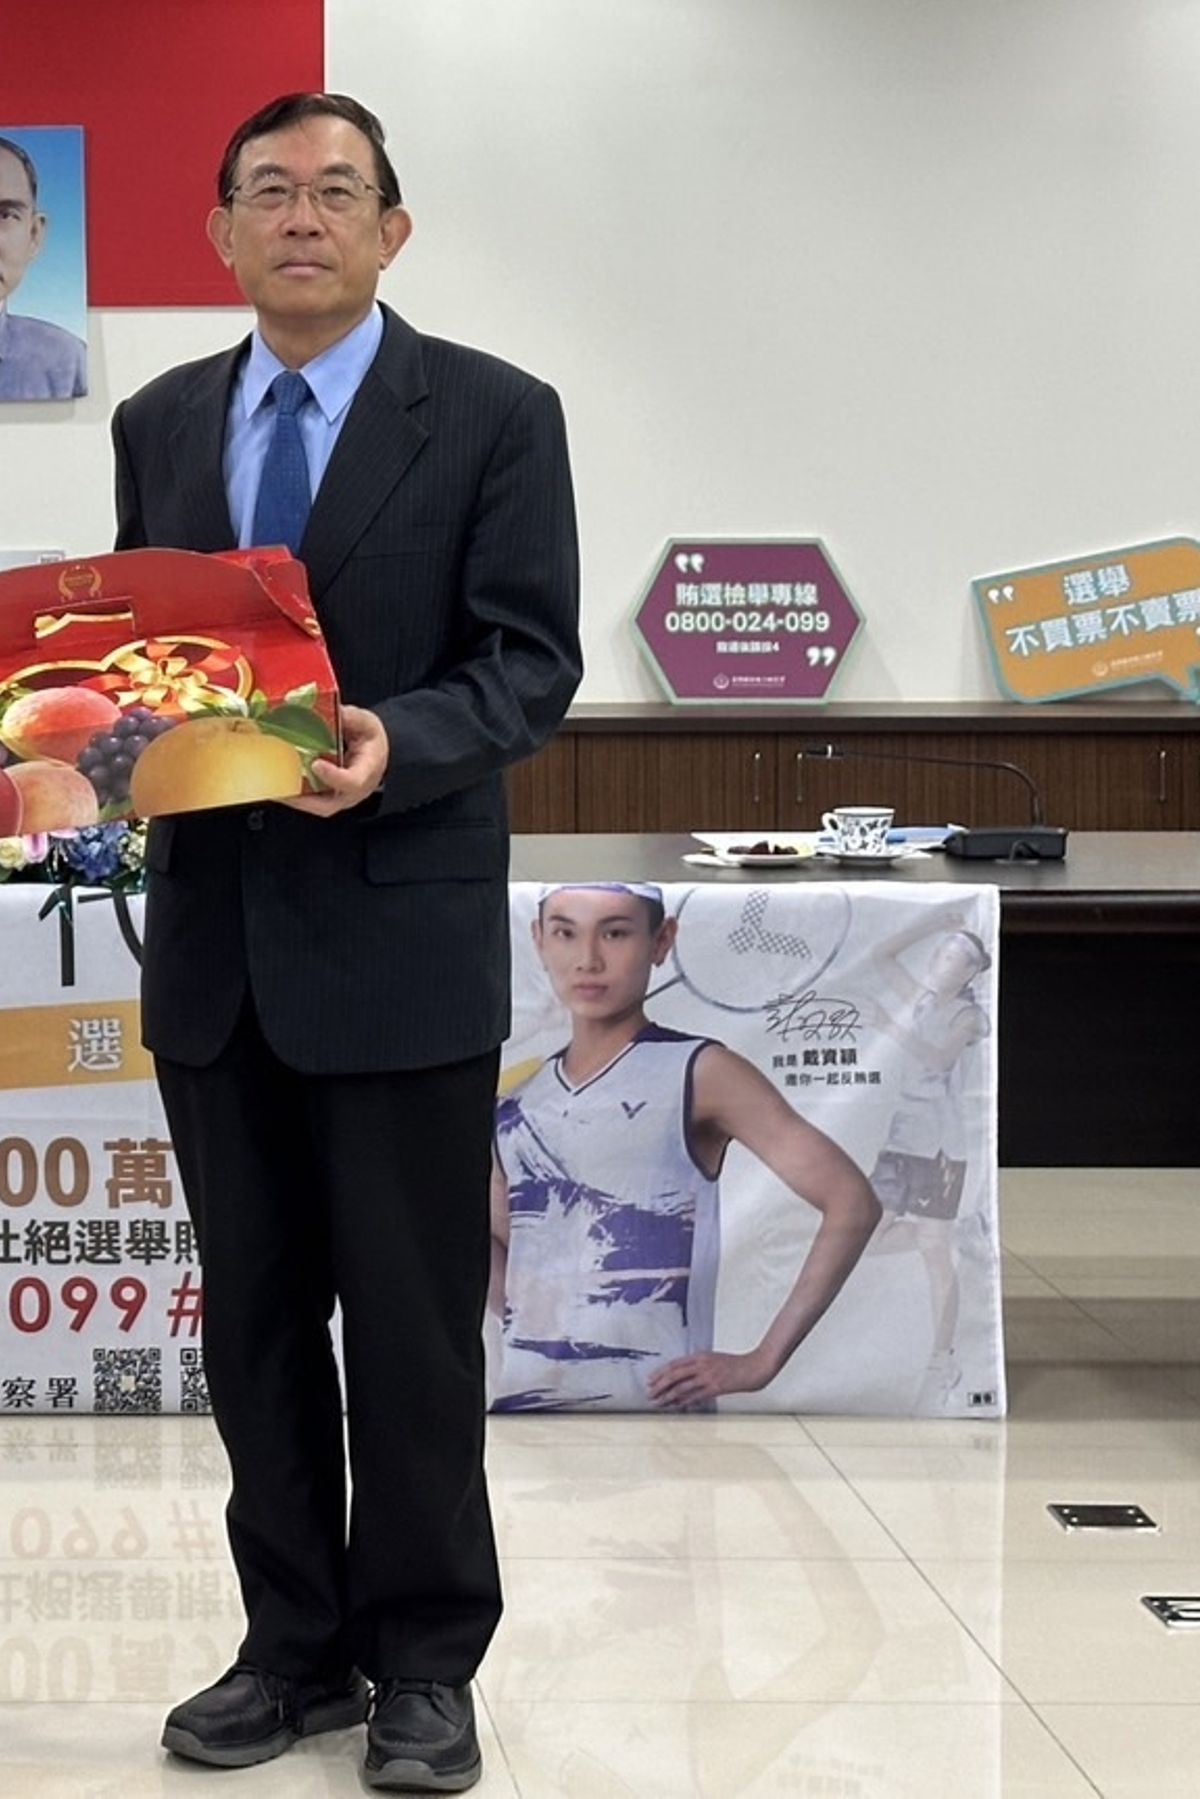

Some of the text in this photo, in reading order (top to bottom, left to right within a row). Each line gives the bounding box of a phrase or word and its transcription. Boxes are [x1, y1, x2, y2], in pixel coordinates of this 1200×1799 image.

[675, 582, 818, 607] 賄選檢舉專線
[1064, 564, 1130, 605] 選舉
[665, 611, 831, 633] 0800-024-099
